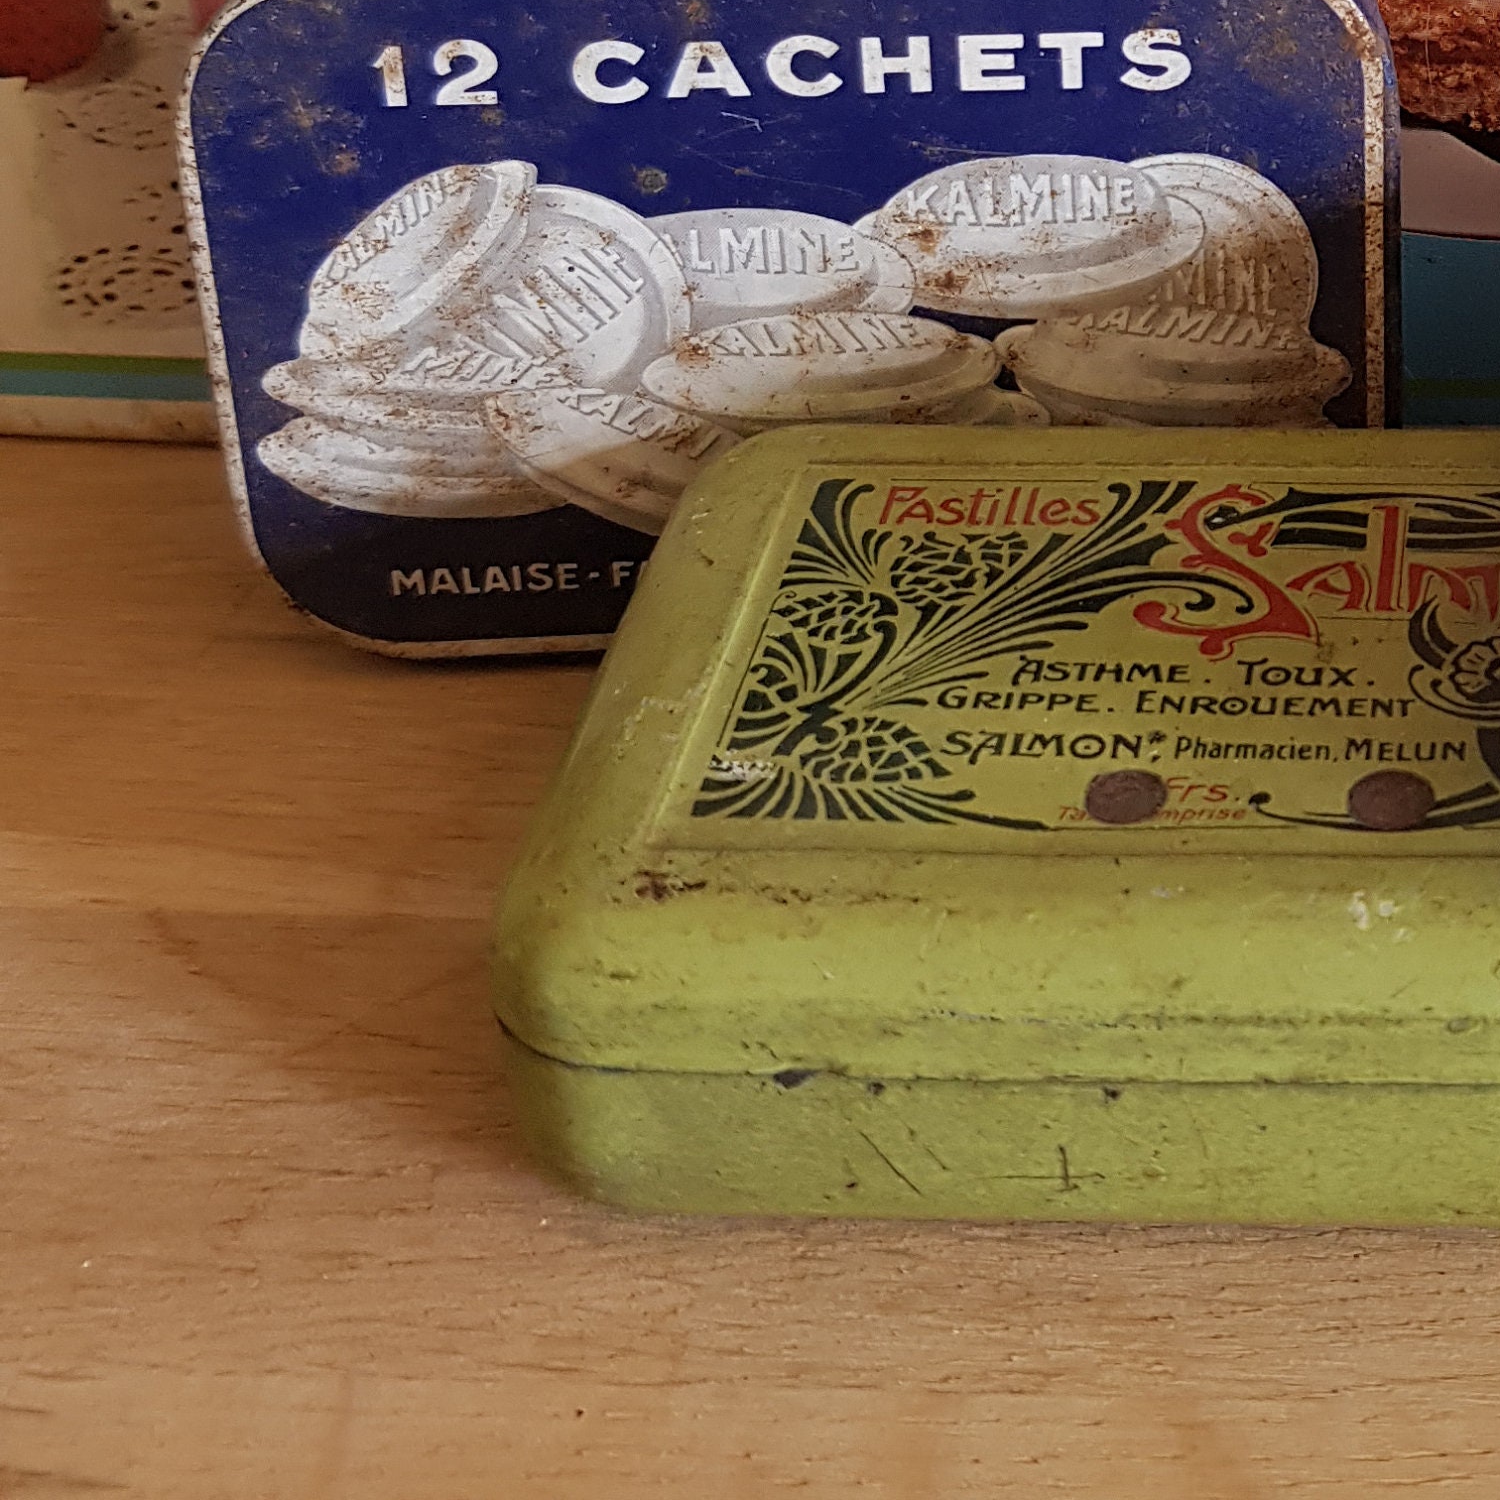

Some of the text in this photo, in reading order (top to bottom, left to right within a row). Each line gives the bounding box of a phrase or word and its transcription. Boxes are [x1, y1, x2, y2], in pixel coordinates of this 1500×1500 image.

[373, 27, 1194, 109] 12 CACHETS
[903, 170, 1138, 228] KALMINE
[1134, 689, 1417, 719] ENROUEMENT
[1344, 736, 1468, 762] MELUN
[1157, 807, 1248, 826] mprise
